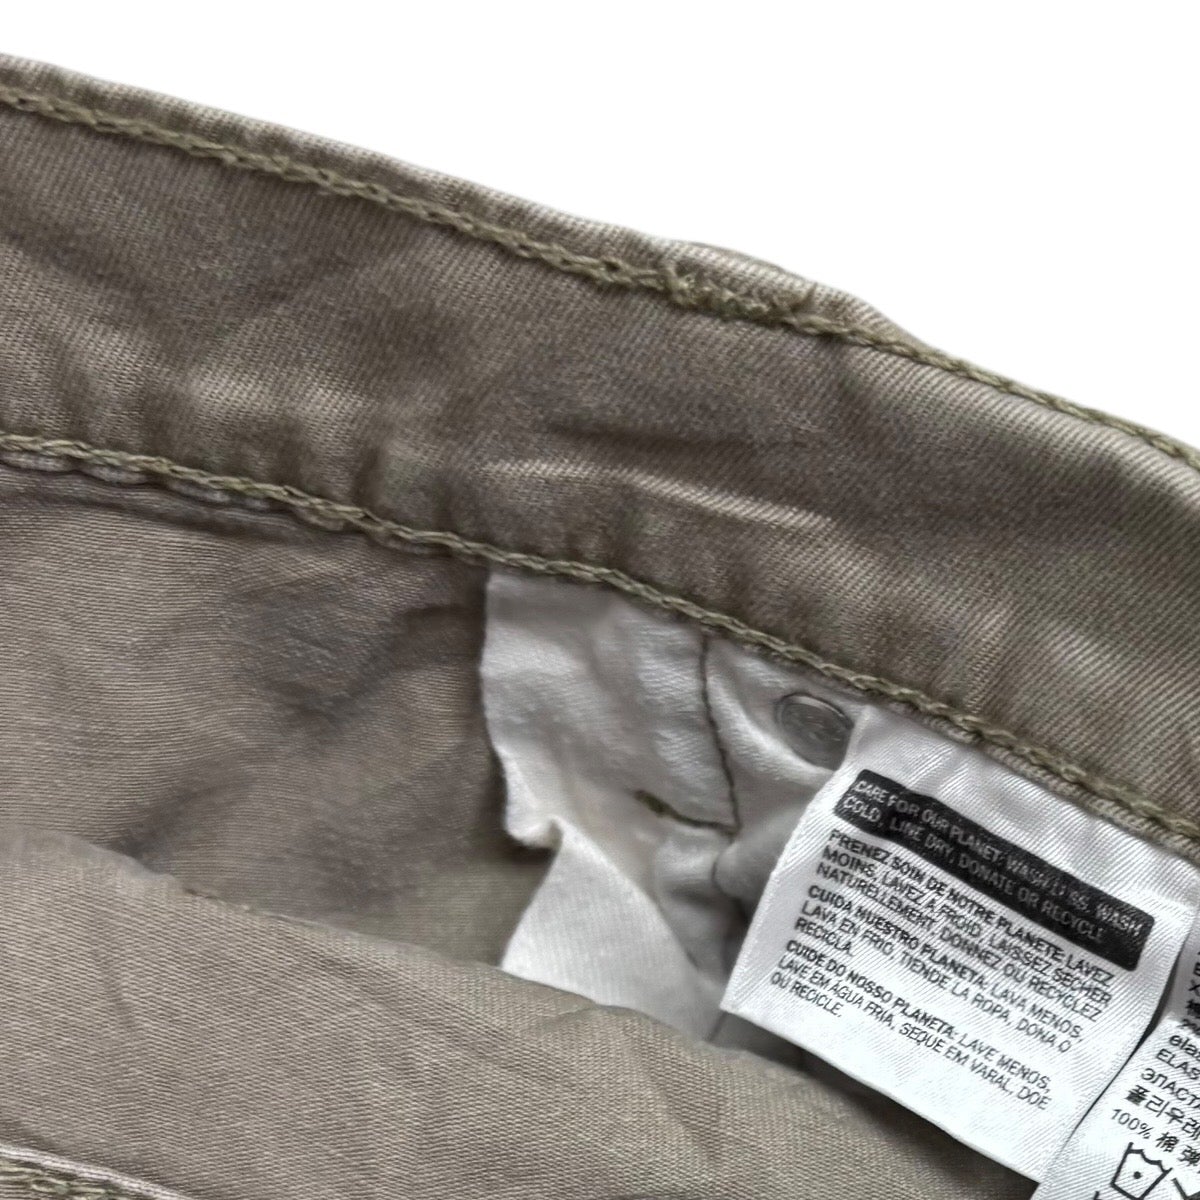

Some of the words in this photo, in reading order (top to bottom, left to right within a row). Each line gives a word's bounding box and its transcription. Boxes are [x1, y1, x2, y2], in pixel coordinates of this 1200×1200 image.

[769, 970, 792, 990] OU
[784, 938, 827, 967] CUIDE
[824, 958, 848, 978] DO
[844, 968, 894, 1005] NOSSO
[956, 1031, 998, 1062] LAVE
[799, 899, 839, 925] LAVA
[896, 950, 952, 990] TIENDE
[949, 980, 971, 1000] LA
[806, 883, 853, 912] CUIDA
[988, 982, 1029, 1012] LAVA
[777, 953, 813, 980] LAVE
[808, 969, 833, 991] EM
[898, 1020, 947, 1054] SEQUE
[942, 1043, 969, 1067] EM
[1015, 1084, 1051, 1111] DOE
[1109, 1106, 1155, 1141] 100%
